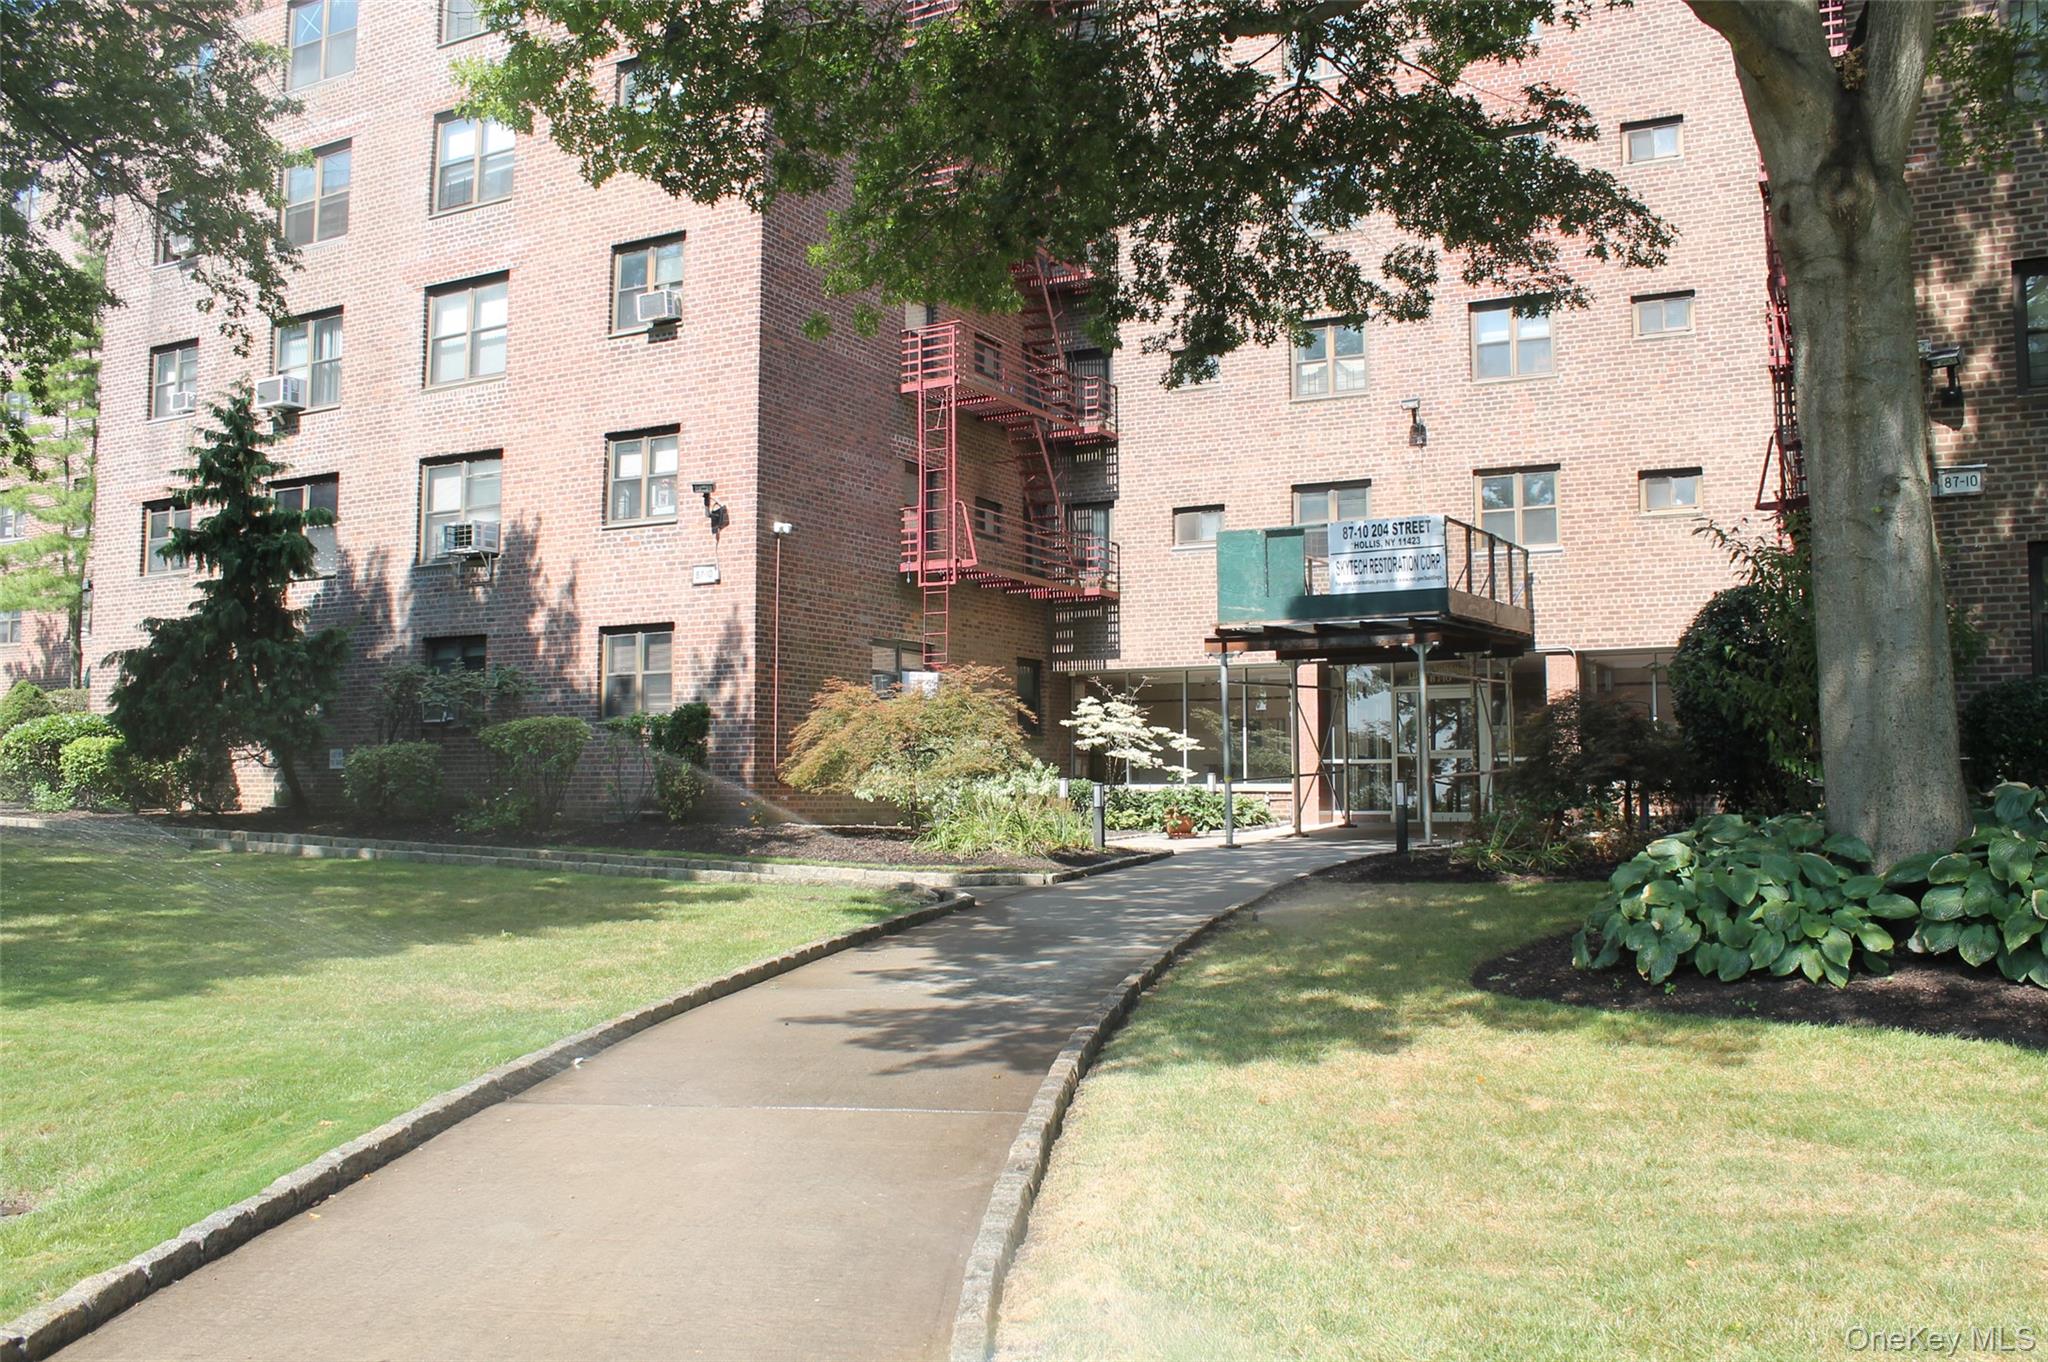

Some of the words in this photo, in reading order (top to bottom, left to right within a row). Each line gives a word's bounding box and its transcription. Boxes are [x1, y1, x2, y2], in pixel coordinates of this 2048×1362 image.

[1944, 475, 1978, 488] 87-10
[1342, 525, 1369, 540] 87-10
[1371, 523, 1389, 538] 204
[1392, 520, 1431, 536] STREET
[1353, 539, 1384, 550] HOLLIS,
[1385, 538, 1396, 548] NY
[1398, 536, 1421, 546] 11423
[1336, 559, 1369, 577] SKYTECH
[1369, 555, 1419, 574] RESTORATION
[1421, 553, 1442, 571] CORP.
